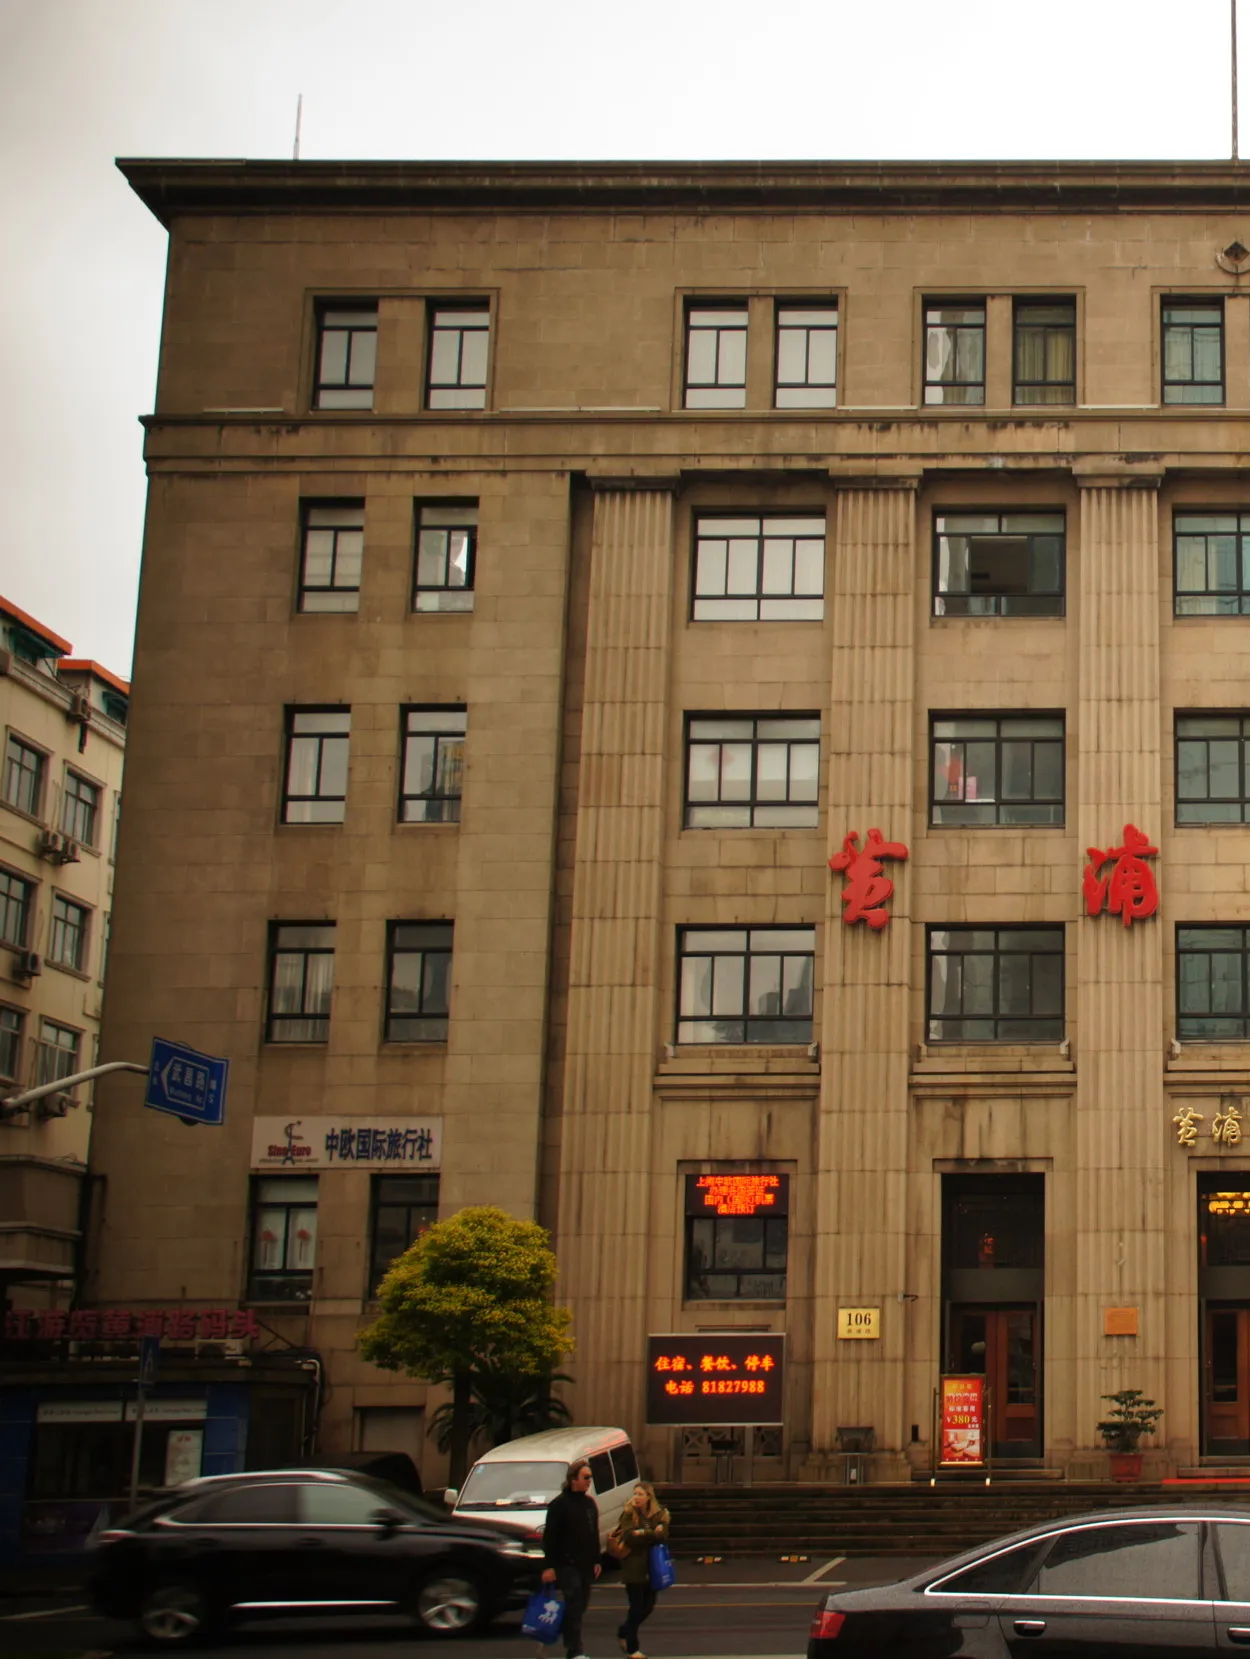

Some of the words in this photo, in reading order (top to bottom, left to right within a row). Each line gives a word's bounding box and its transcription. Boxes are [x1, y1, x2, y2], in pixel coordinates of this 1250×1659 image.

[326, 1128, 432, 1161] 中欧国际旅行社
[847, 1312, 871, 1326] 106
[665, 1380, 695, 1395] 电话
[702, 1380, 765, 1394] 81827988
